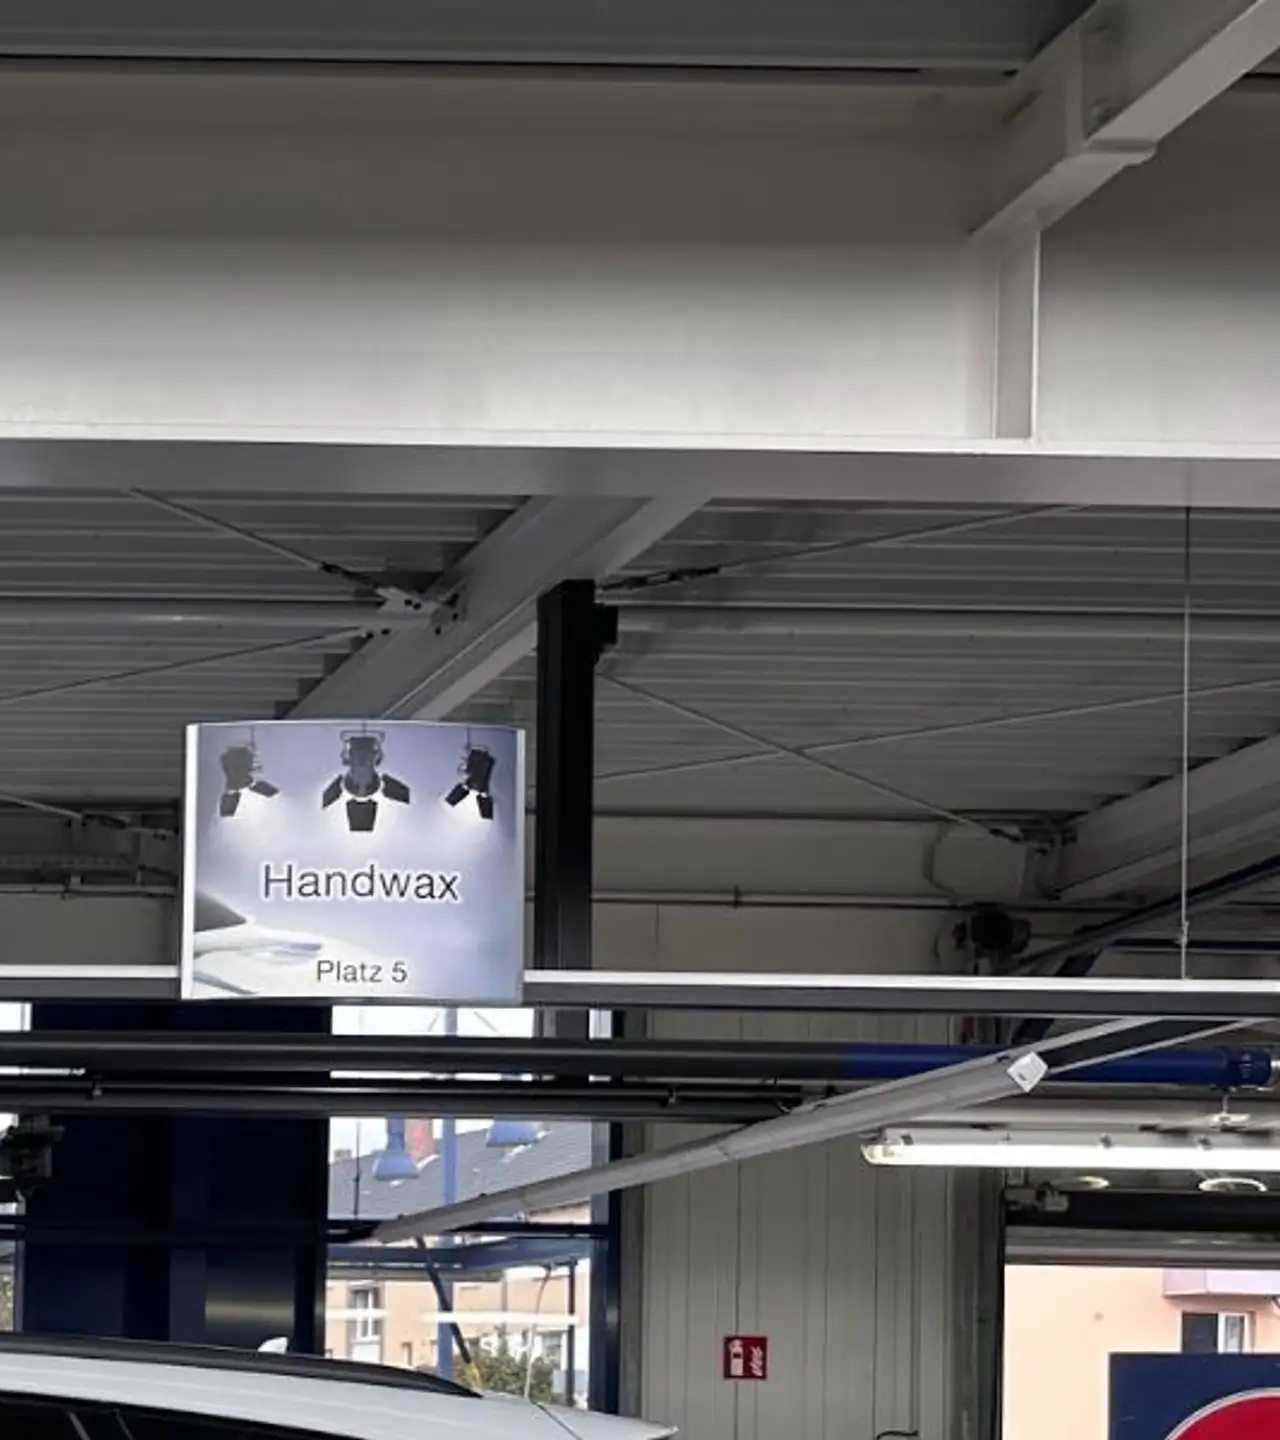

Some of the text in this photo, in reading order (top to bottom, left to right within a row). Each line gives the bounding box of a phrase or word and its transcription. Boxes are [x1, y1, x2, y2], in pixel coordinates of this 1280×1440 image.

[263, 863, 459, 900] Handwax
[316, 960, 408, 983] Platz 5
